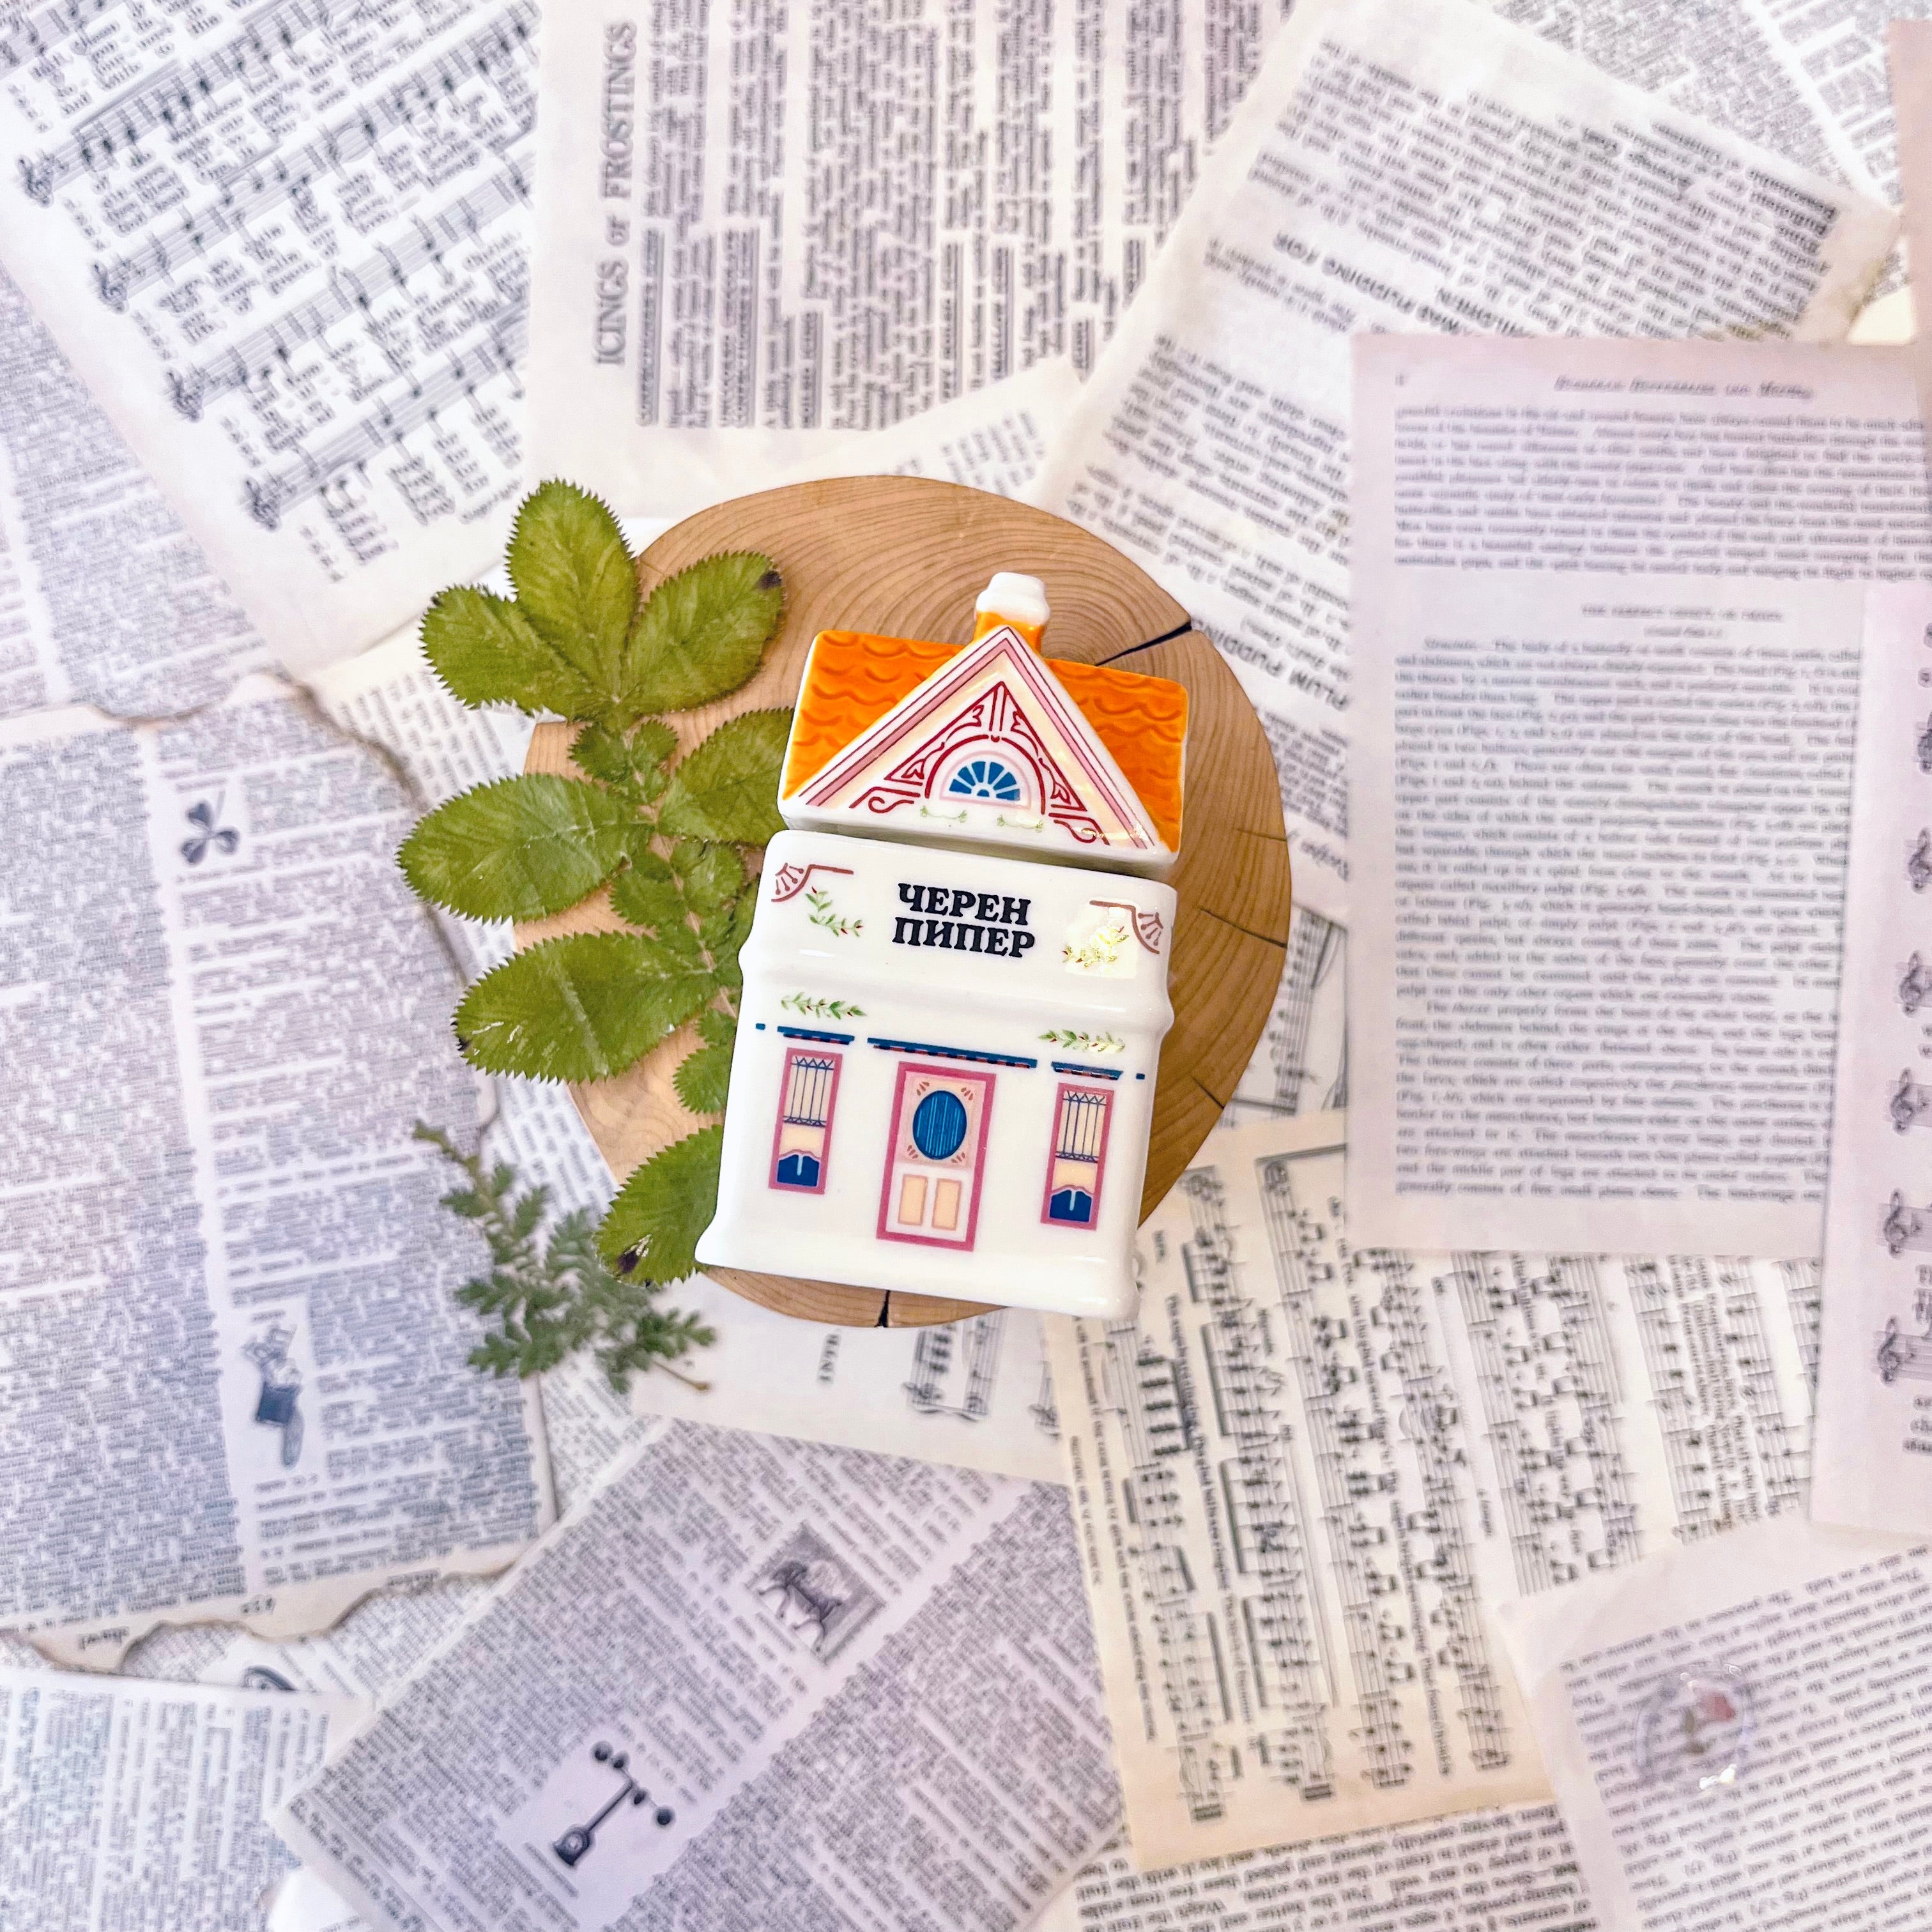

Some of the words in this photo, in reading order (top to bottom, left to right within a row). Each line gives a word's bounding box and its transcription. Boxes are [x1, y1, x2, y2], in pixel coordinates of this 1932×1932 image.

[601, 20, 637, 200] FROSTINGS
[594, 257, 629, 366] ICINGS
[1289, 668, 1349, 712] PLUM
[898, 883, 1031, 925] ЧЕРЕН
[892, 916, 1035, 958] ПИПЕР
